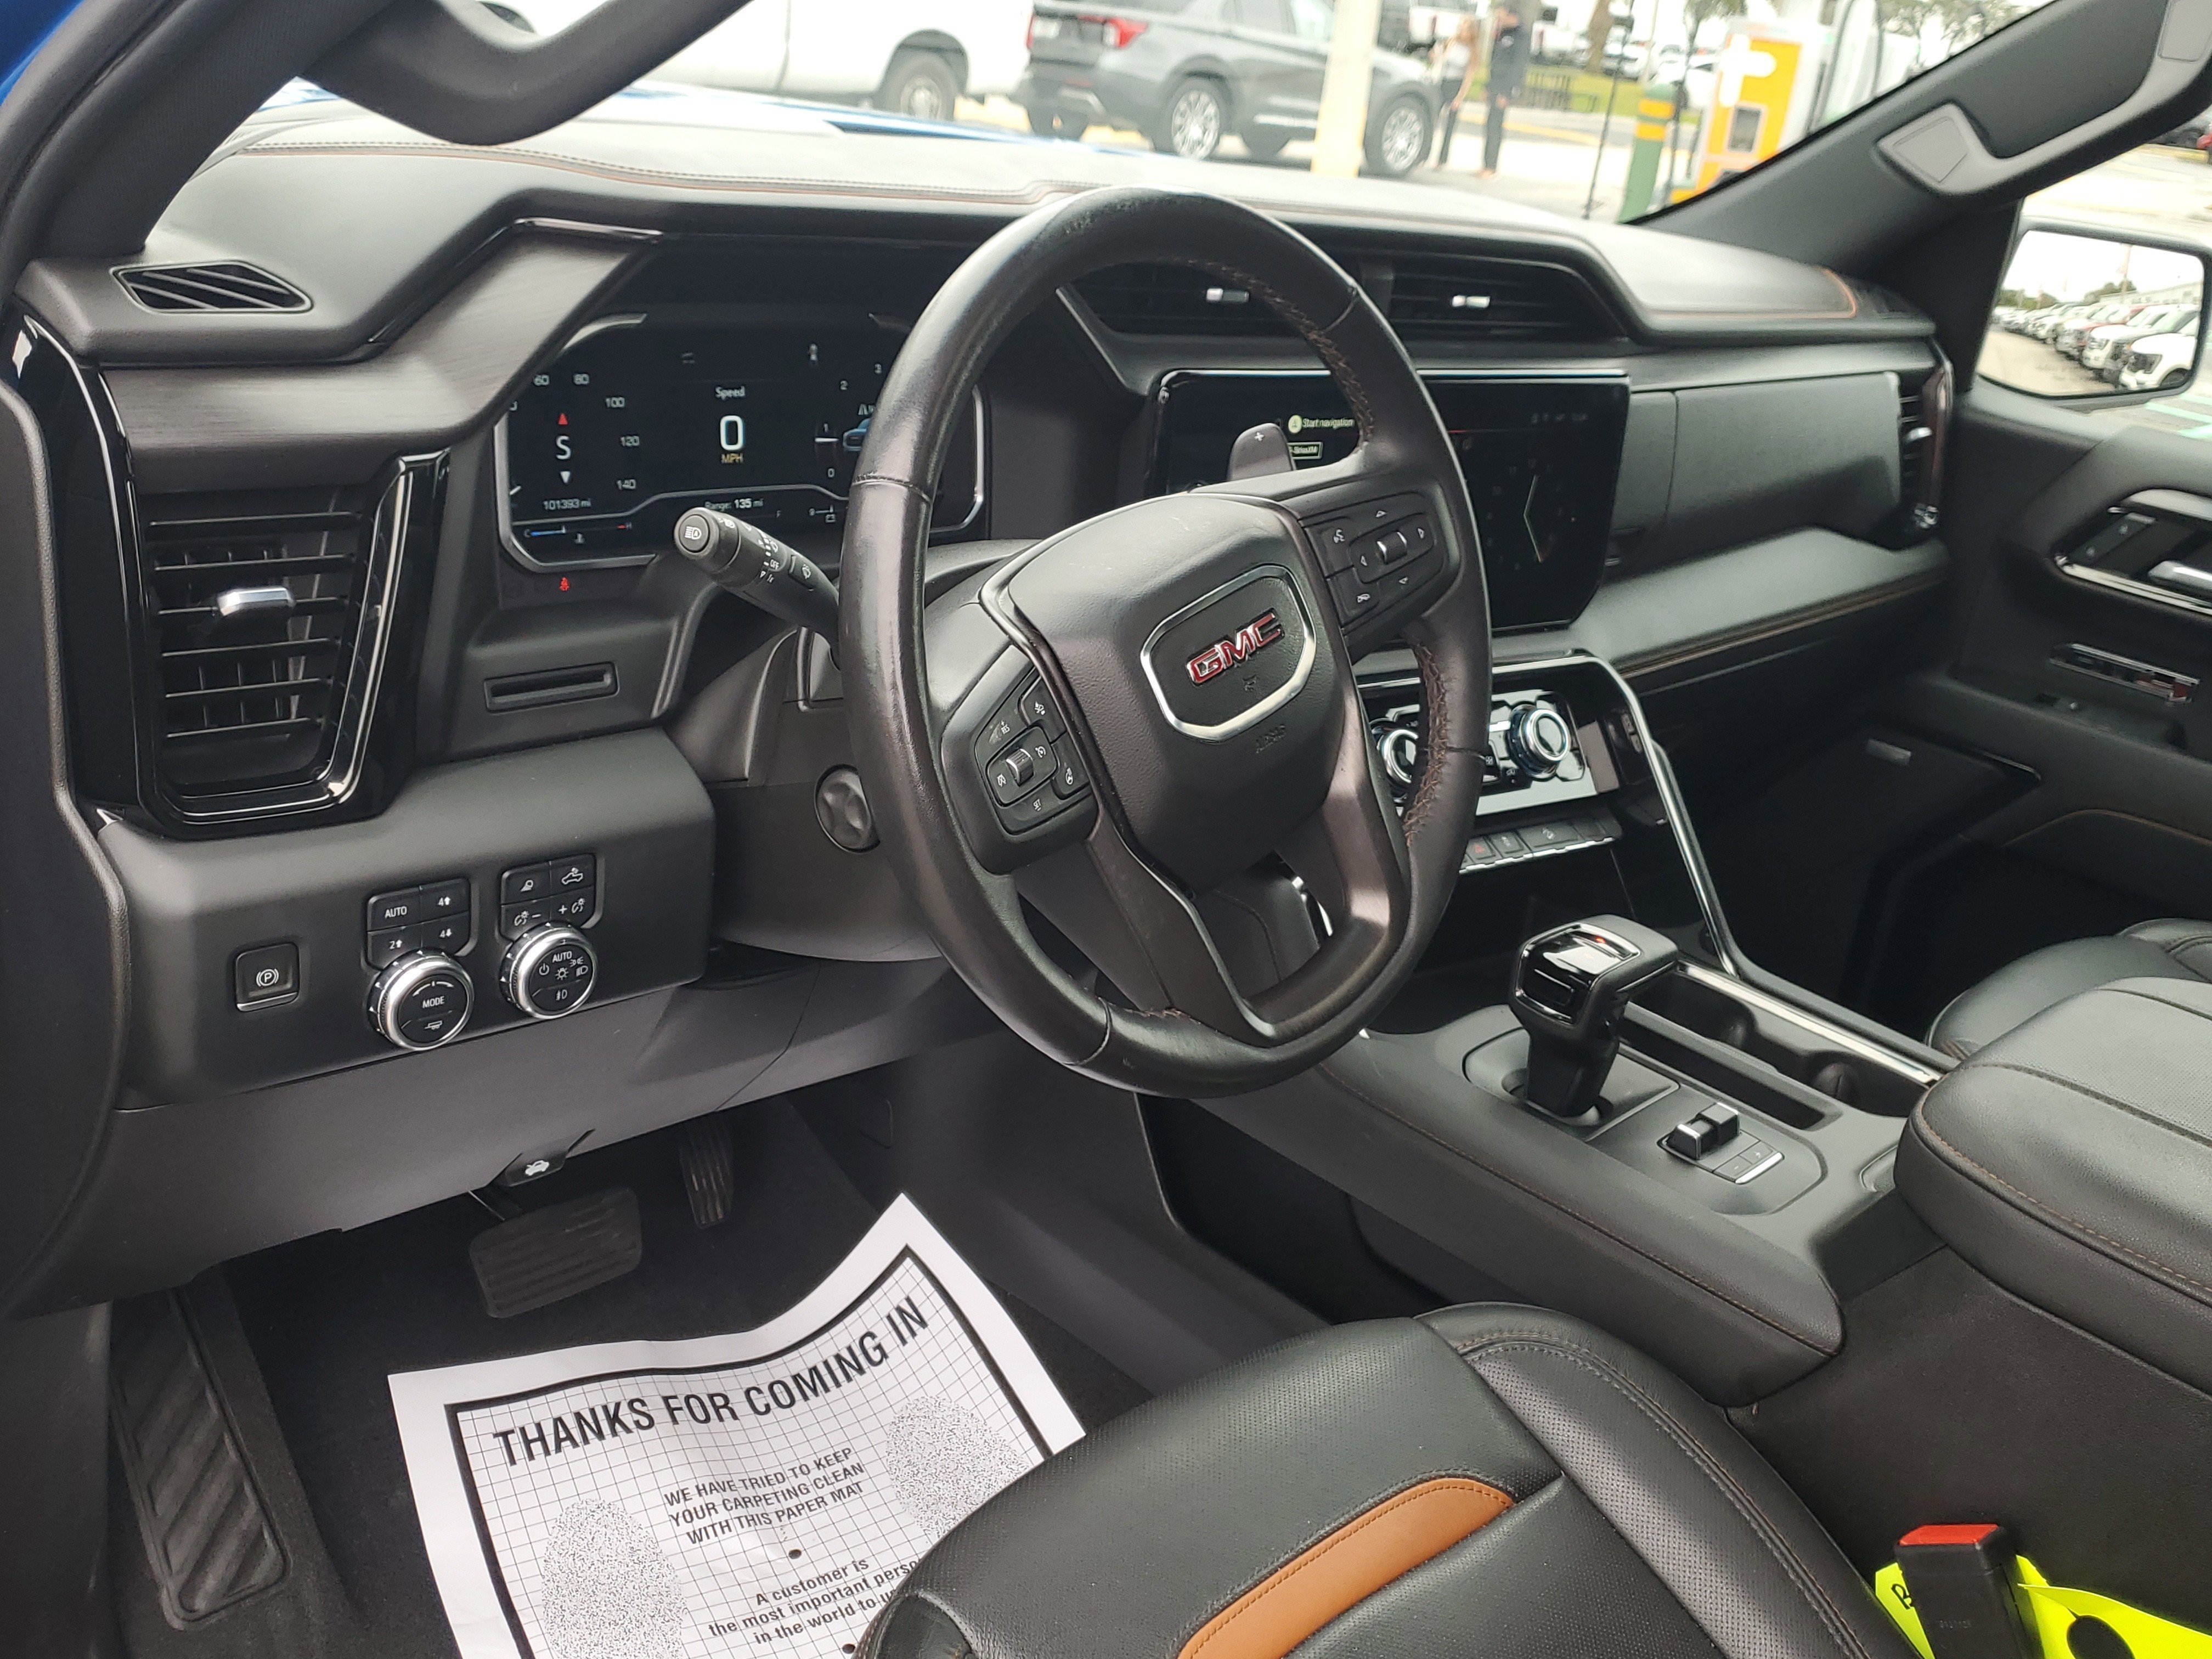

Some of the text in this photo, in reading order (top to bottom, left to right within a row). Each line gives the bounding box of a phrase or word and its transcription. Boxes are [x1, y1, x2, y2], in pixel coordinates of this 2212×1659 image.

[840, 381, 848, 390] 2
[715, 386, 745, 400] Speed
[605, 397, 625, 408] 100
[1302, 417, 1355, 430] Start navigation
[556, 435, 572, 460] S
[620, 436, 640, 447] 120
[721, 453, 743, 464] MPH
[617, 479, 636, 490] 140
[581, 498, 592, 507] mi
[734, 498, 752, 509] 135
[770, 559, 780, 570] OFF
[1187, 612, 1283, 684] GMC
[385, 906, 408, 918] AUTO
[552, 951, 573, 963] AUTO
[422, 996, 445, 1008] MODE
[494, 1296, 929, 1466] THANKS FOR COMING IN
[664, 1447, 853, 1507] WE HAVE TRIED TO KEEP
[669, 1462, 865, 1528] YOUR CARPETING CLEAN
[686, 1481, 865, 1545] WITH THIS PAPER MAT
[756, 1559, 870, 1606] A customer is
[709, 1560, 921, 1637] the most important perso
[753, 1589, 896, 1644] in the world to u
